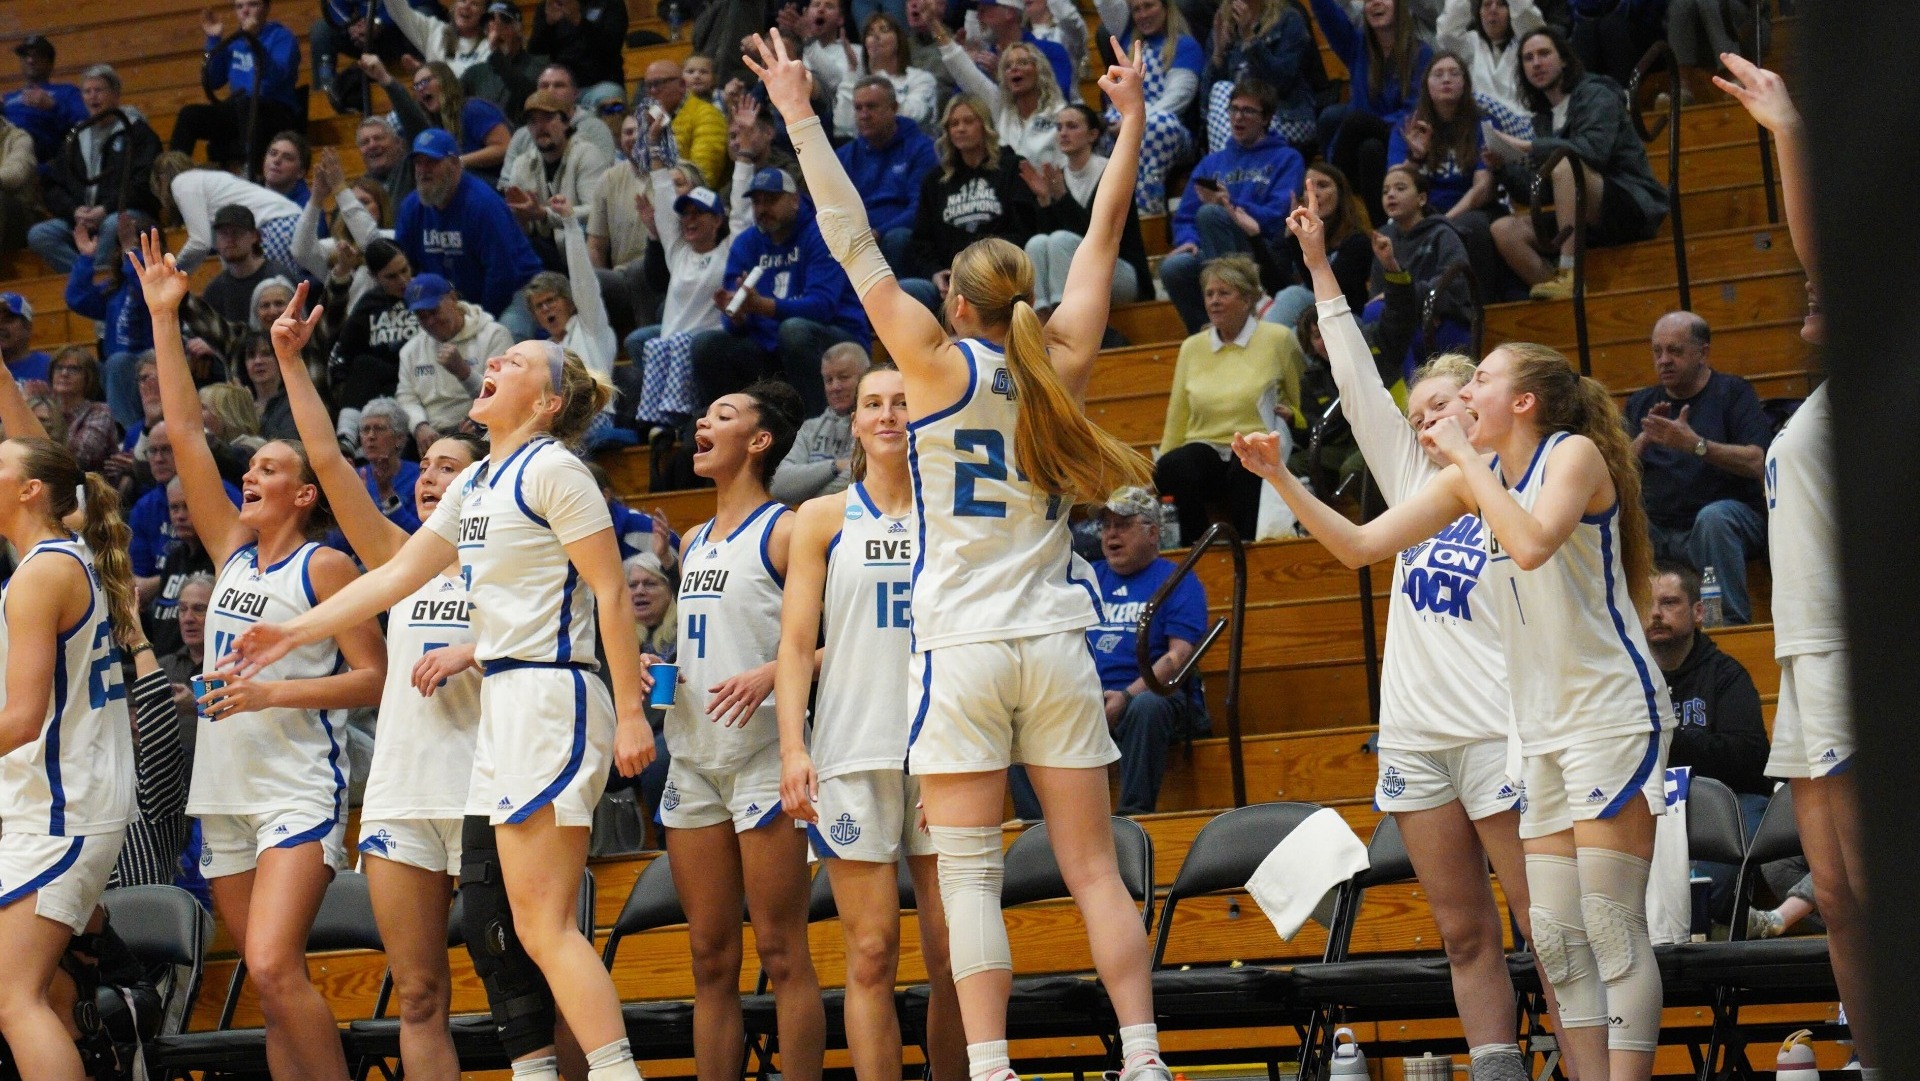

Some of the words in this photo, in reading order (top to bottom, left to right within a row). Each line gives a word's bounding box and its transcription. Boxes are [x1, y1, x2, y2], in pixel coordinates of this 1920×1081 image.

[369, 326, 419, 346] NATIO
[865, 539, 911, 560] GVS
[1434, 548, 1481, 571] ON
[683, 569, 730, 593] GVSU
[217, 587, 269, 618] GVSU
[410, 600, 471, 622] GVSU
[688, 613, 707, 659] 4
